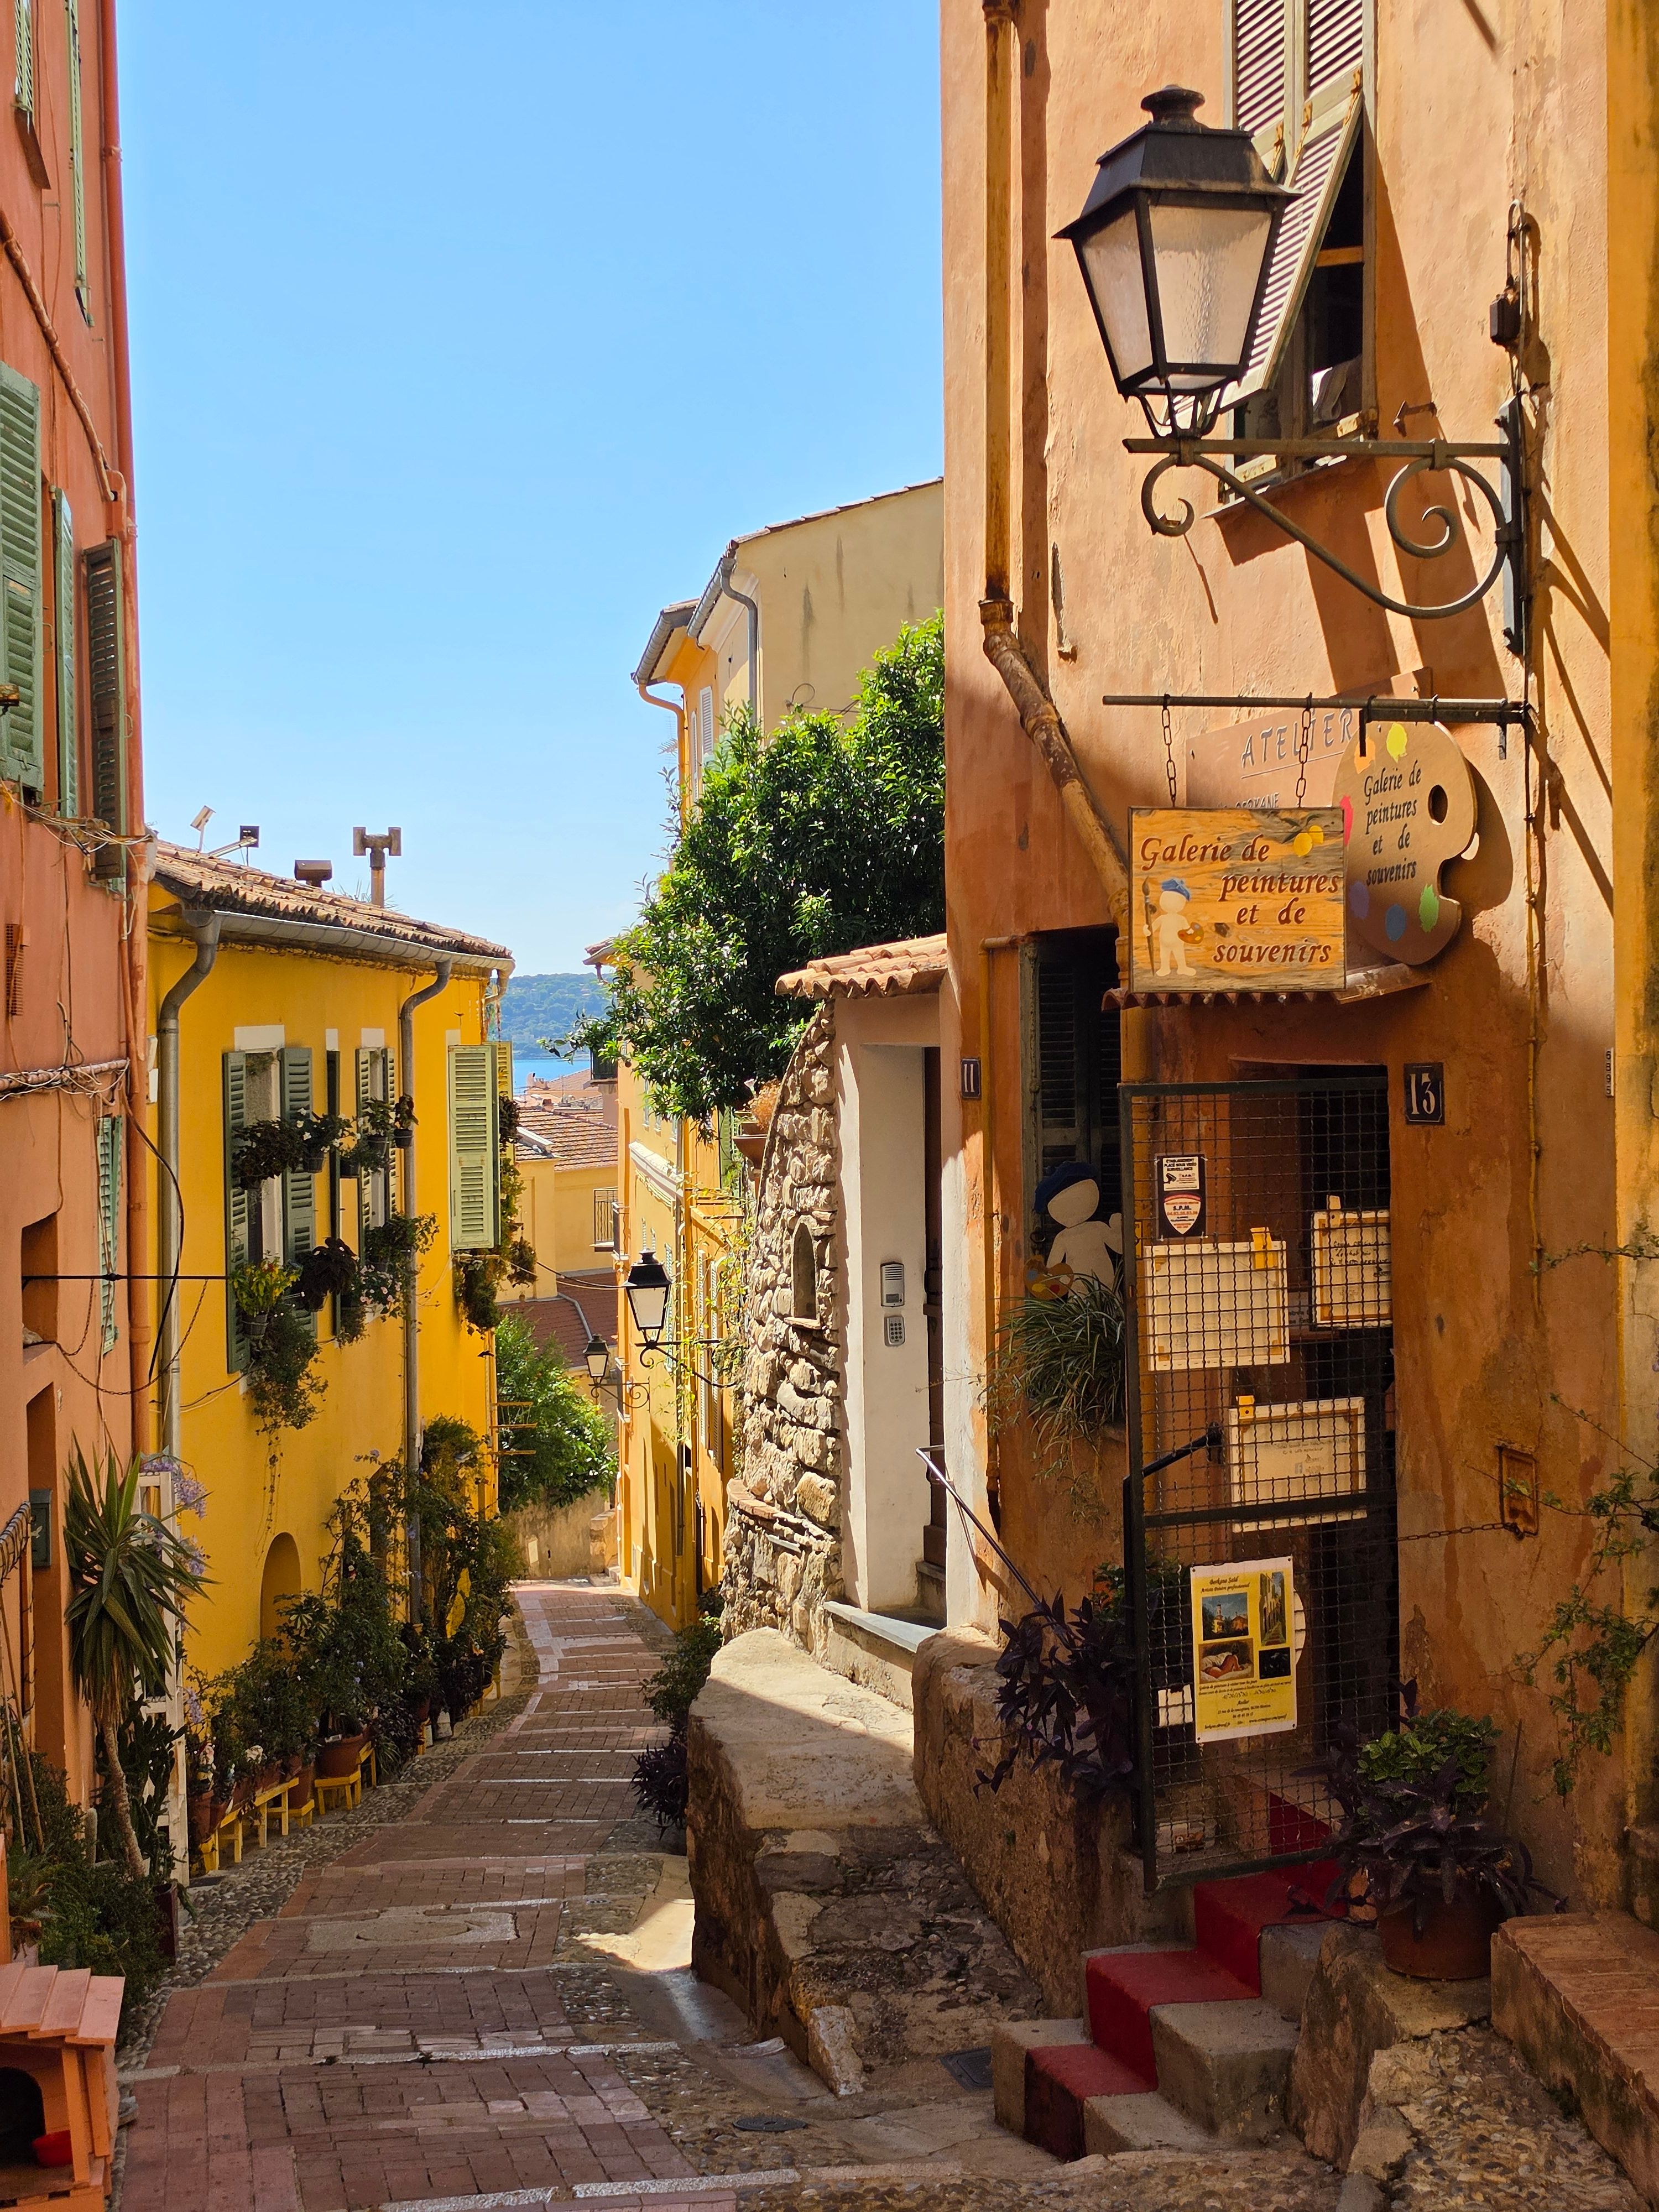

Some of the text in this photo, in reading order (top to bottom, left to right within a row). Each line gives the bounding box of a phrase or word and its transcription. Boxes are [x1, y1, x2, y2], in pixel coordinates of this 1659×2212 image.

[1241, 708, 1353, 769] ATELIER
[1364, 759, 1422, 806] Galerie de
[1365, 799, 1417, 835] peintures
[1139, 833, 1270, 872] Galerie de
[1373, 823, 1411, 855] et de
[1217, 868, 1339, 902] peintures
[1366, 857, 1417, 886] souvenirs
[1235, 896, 1307, 925] et de
[1212, 938, 1333, 963] souvenirs
[964, 1064, 975, 1093] 11
[1410, 1073, 1436, 1115] 13
